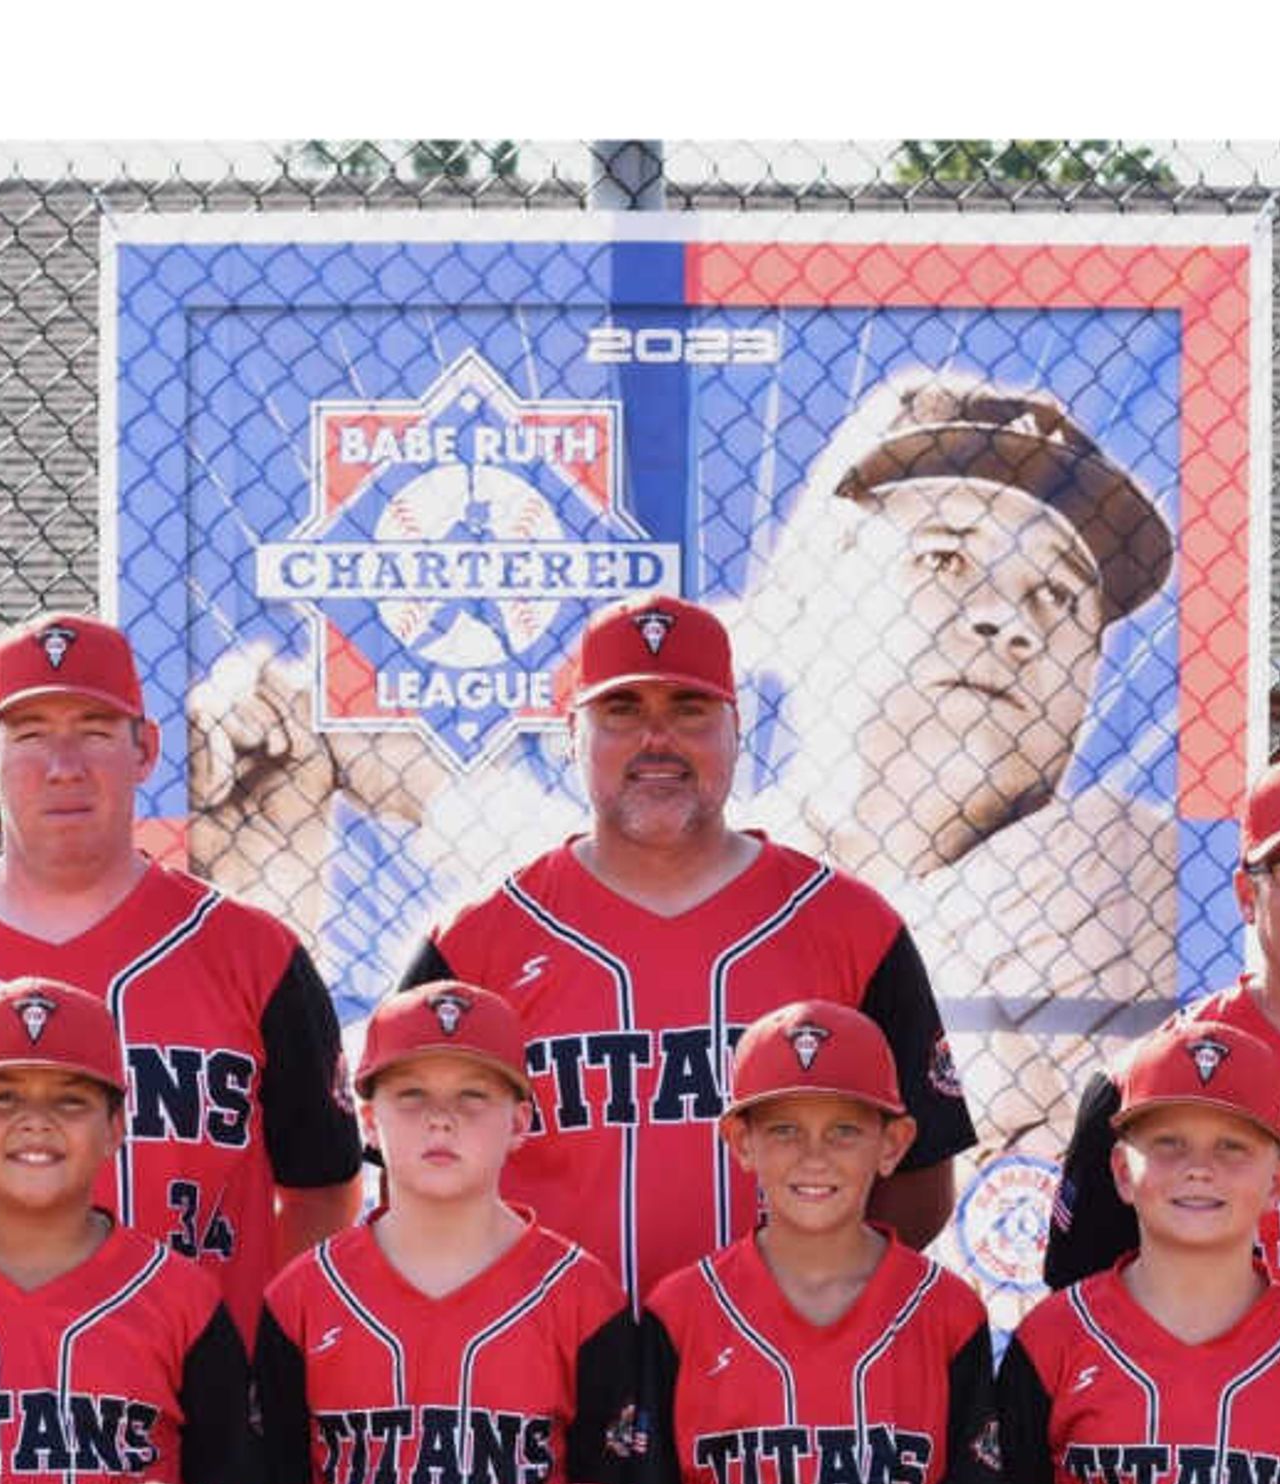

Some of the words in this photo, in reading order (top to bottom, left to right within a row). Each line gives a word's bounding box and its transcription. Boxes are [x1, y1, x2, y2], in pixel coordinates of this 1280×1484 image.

[585, 327, 785, 364] 2023
[340, 426, 459, 466] BABE
[473, 426, 599, 466] RUTH
[279, 550, 665, 591] CHARTERED
[376, 671, 554, 711] LEAGUE
[522, 1027, 747, 1138] ITA
[167, 1181, 237, 1262] 34
